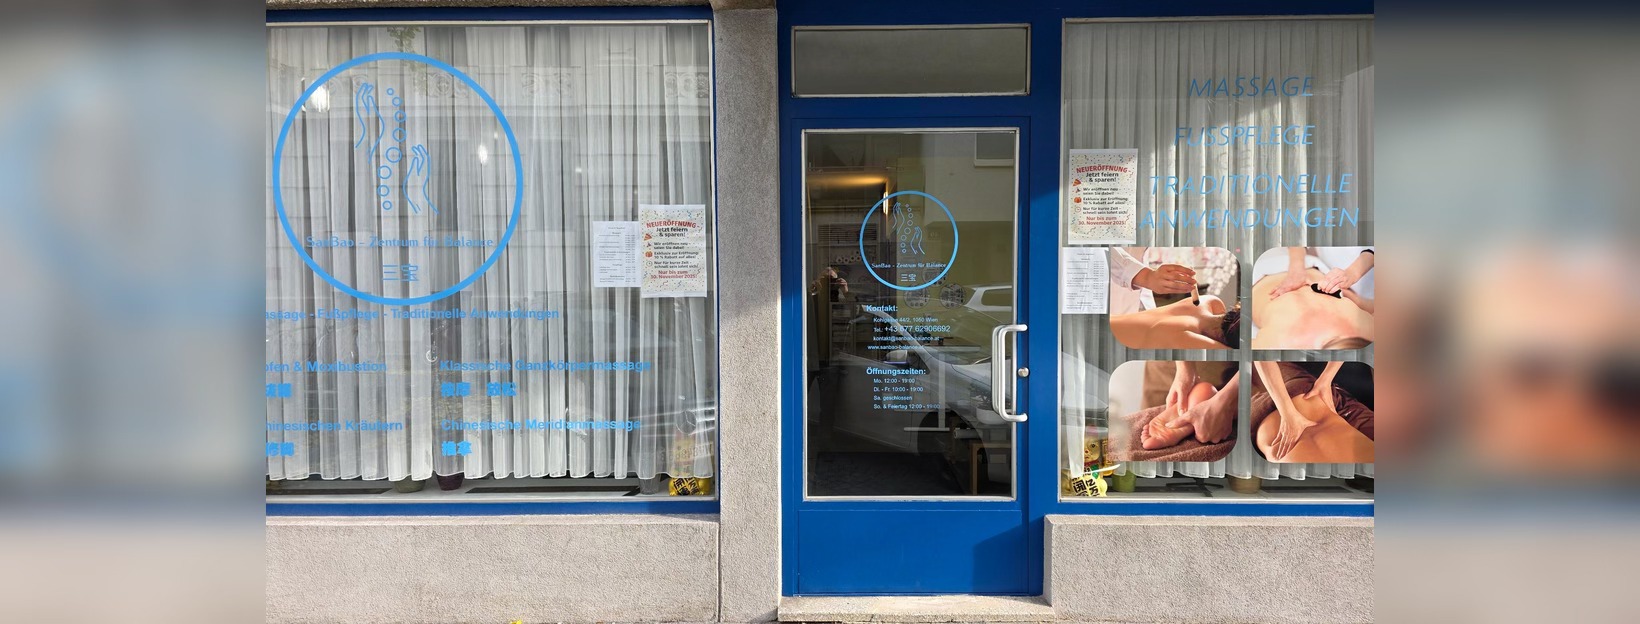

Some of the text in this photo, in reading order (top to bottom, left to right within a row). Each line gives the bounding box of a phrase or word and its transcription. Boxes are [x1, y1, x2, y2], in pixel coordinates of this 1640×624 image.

[1188, 76, 1315, 97] MASSAGE
[1174, 125, 1316, 147] FUSSPFLEGE
[1076, 164, 1128, 173] NEUERÖFFNUNG
[1149, 173, 1353, 196] TRADITIONELLE
[646, 220, 696, 229] NEUERÖFFNUNG
[1139, 207, 1359, 229] ANWENDUNGEN
[307, 236, 355, 247] SanBao
[369, 236, 419, 247] Zentrum
[423, 236, 438, 247] für
[444, 236, 494, 247] Balance
[382, 264, 420, 282] 三宝
[317, 308, 378, 321] Fußpflege
[390, 308, 466, 319] Traditionelle
[469, 308, 559, 321] Anwendungen
[884, 325, 898, 333] +43
[293, 361, 303, 372] &
[306, 360, 387, 372] Moxibustion
[439, 359, 651, 373] Klassische Ganzkörpermassage
[866, 366, 926, 376] Öffnungszeiten:
[345, 420, 403, 431] Kräutern
[441, 419, 641, 432] Chinesische Meridianmassage
